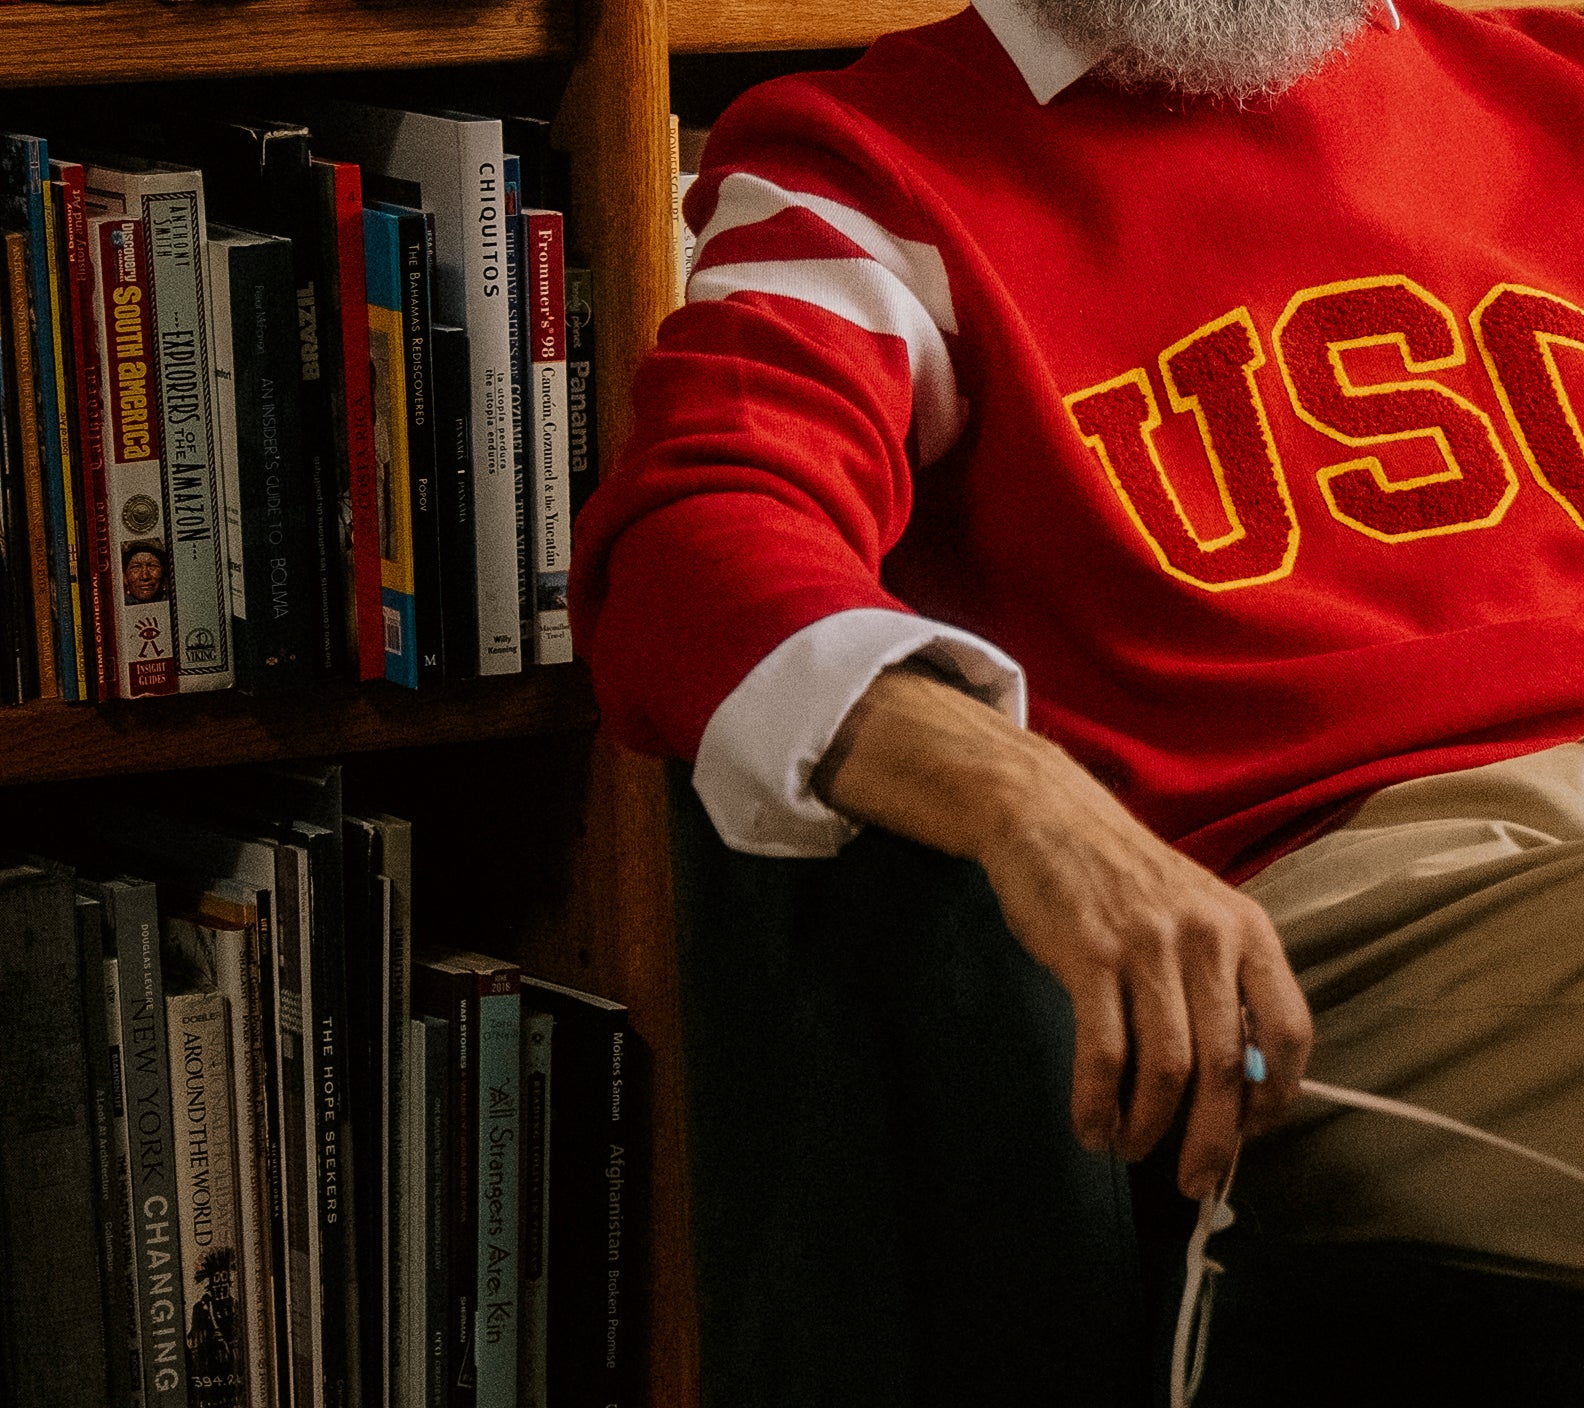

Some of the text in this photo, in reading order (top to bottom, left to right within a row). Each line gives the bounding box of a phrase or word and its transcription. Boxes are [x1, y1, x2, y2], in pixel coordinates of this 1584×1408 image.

[153, 218, 172, 258] SMITH
[479, 163, 499, 298] CHIQUITOS
[295, 280, 320, 382] BRAZIL
[407, 242, 426, 426] THE BAHAMAS REDISCOVERED
[570, 360, 590, 472] Panama
[541, 367, 560, 567] Cancún, Cozumel & the Yucatán
[139, 923, 154, 1011] DOUGLAS LEVERE
[130, 997, 180, 1393] NEW YORK CHANGING
[182, 1030, 213, 1247] AROUND THE WORLD
[322, 1016, 338, 1226] THE HOPE SEEKERS
[483, 1085, 515, 1345] All Strangers Are Kin
[605, 1032, 625, 1369] Moises Saman Afghanistan Broken Promise
